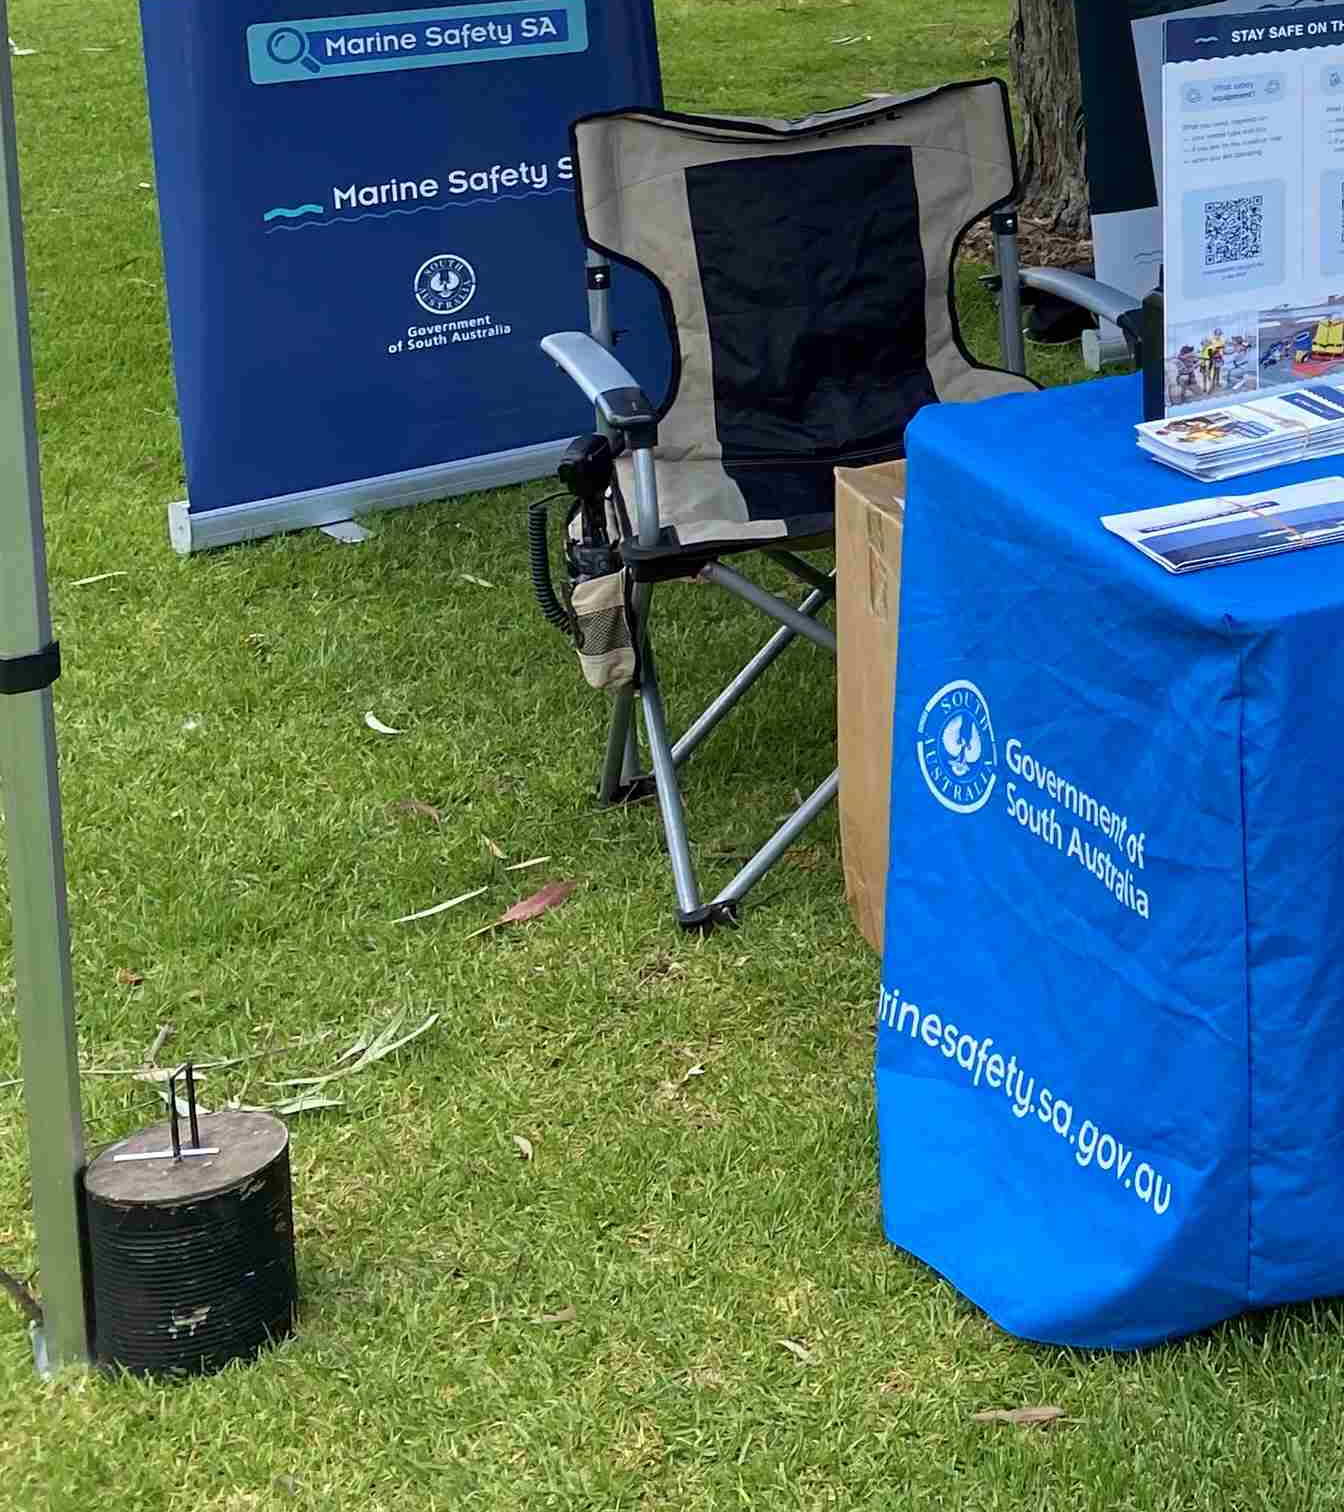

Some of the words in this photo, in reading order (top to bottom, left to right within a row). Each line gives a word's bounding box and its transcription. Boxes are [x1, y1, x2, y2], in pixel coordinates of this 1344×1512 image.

[325, 29, 416, 57] Marine
[425, 20, 513, 49] Safety
[521, 16, 557, 37] SA
[1231, 29, 1266, 44] STAY
[1269, 25, 1304, 39] SAFE
[1307, 21, 1328, 36] ON
[333, 177, 438, 209] Marine
[448, 161, 548, 195] Safety
[558, 155, 573, 179] S
[424, 259, 462, 277] SOUTH
[388, 341, 403, 355] of
[407, 333, 446, 352] South
[451, 324, 512, 345] Australia
[407, 314, 491, 338] Government
[940, 694, 990, 736] SOUTH
[1006, 738, 1128, 852] Government
[1127, 830, 1146, 869] of
[1007, 783, 1062, 851] South
[1067, 826, 1150, 921] Australia
